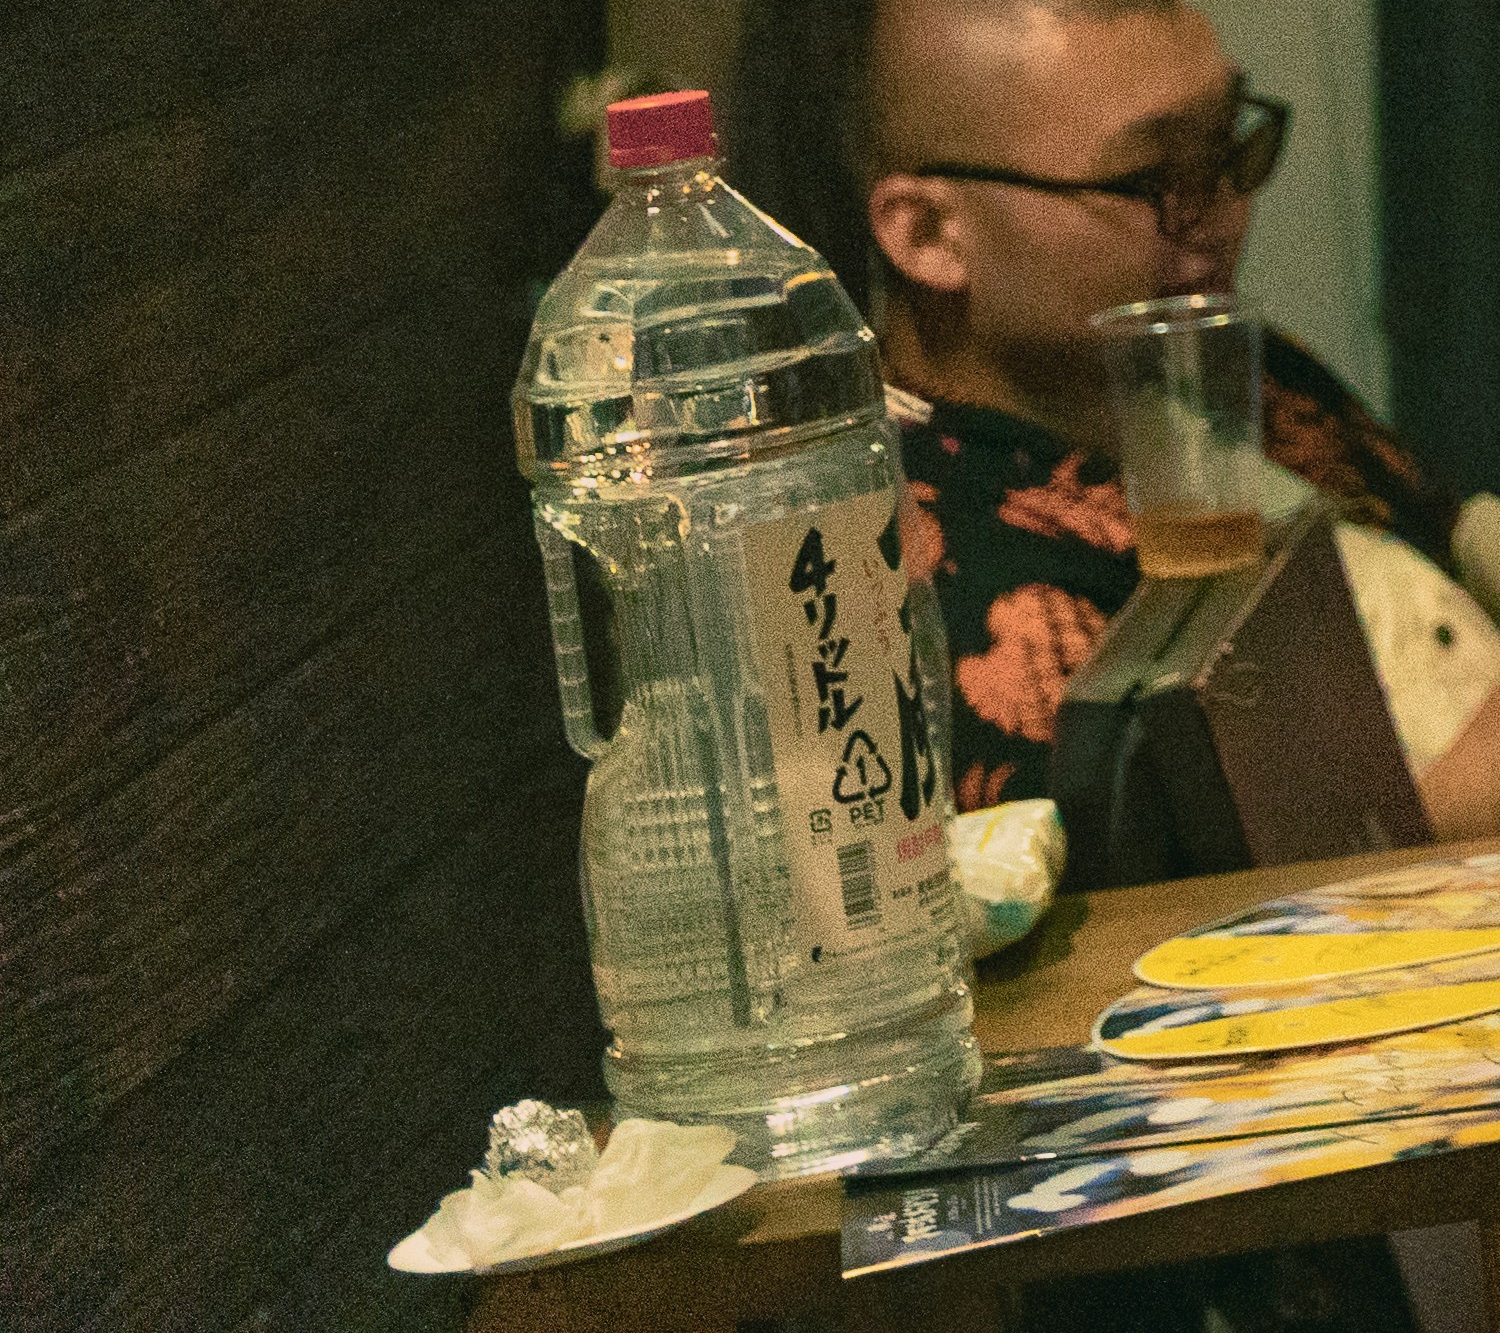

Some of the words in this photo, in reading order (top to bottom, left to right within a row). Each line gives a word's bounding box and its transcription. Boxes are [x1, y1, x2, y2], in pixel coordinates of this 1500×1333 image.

[788, 526, 865, 733] 4リットル
[849, 798, 885, 824] PET
